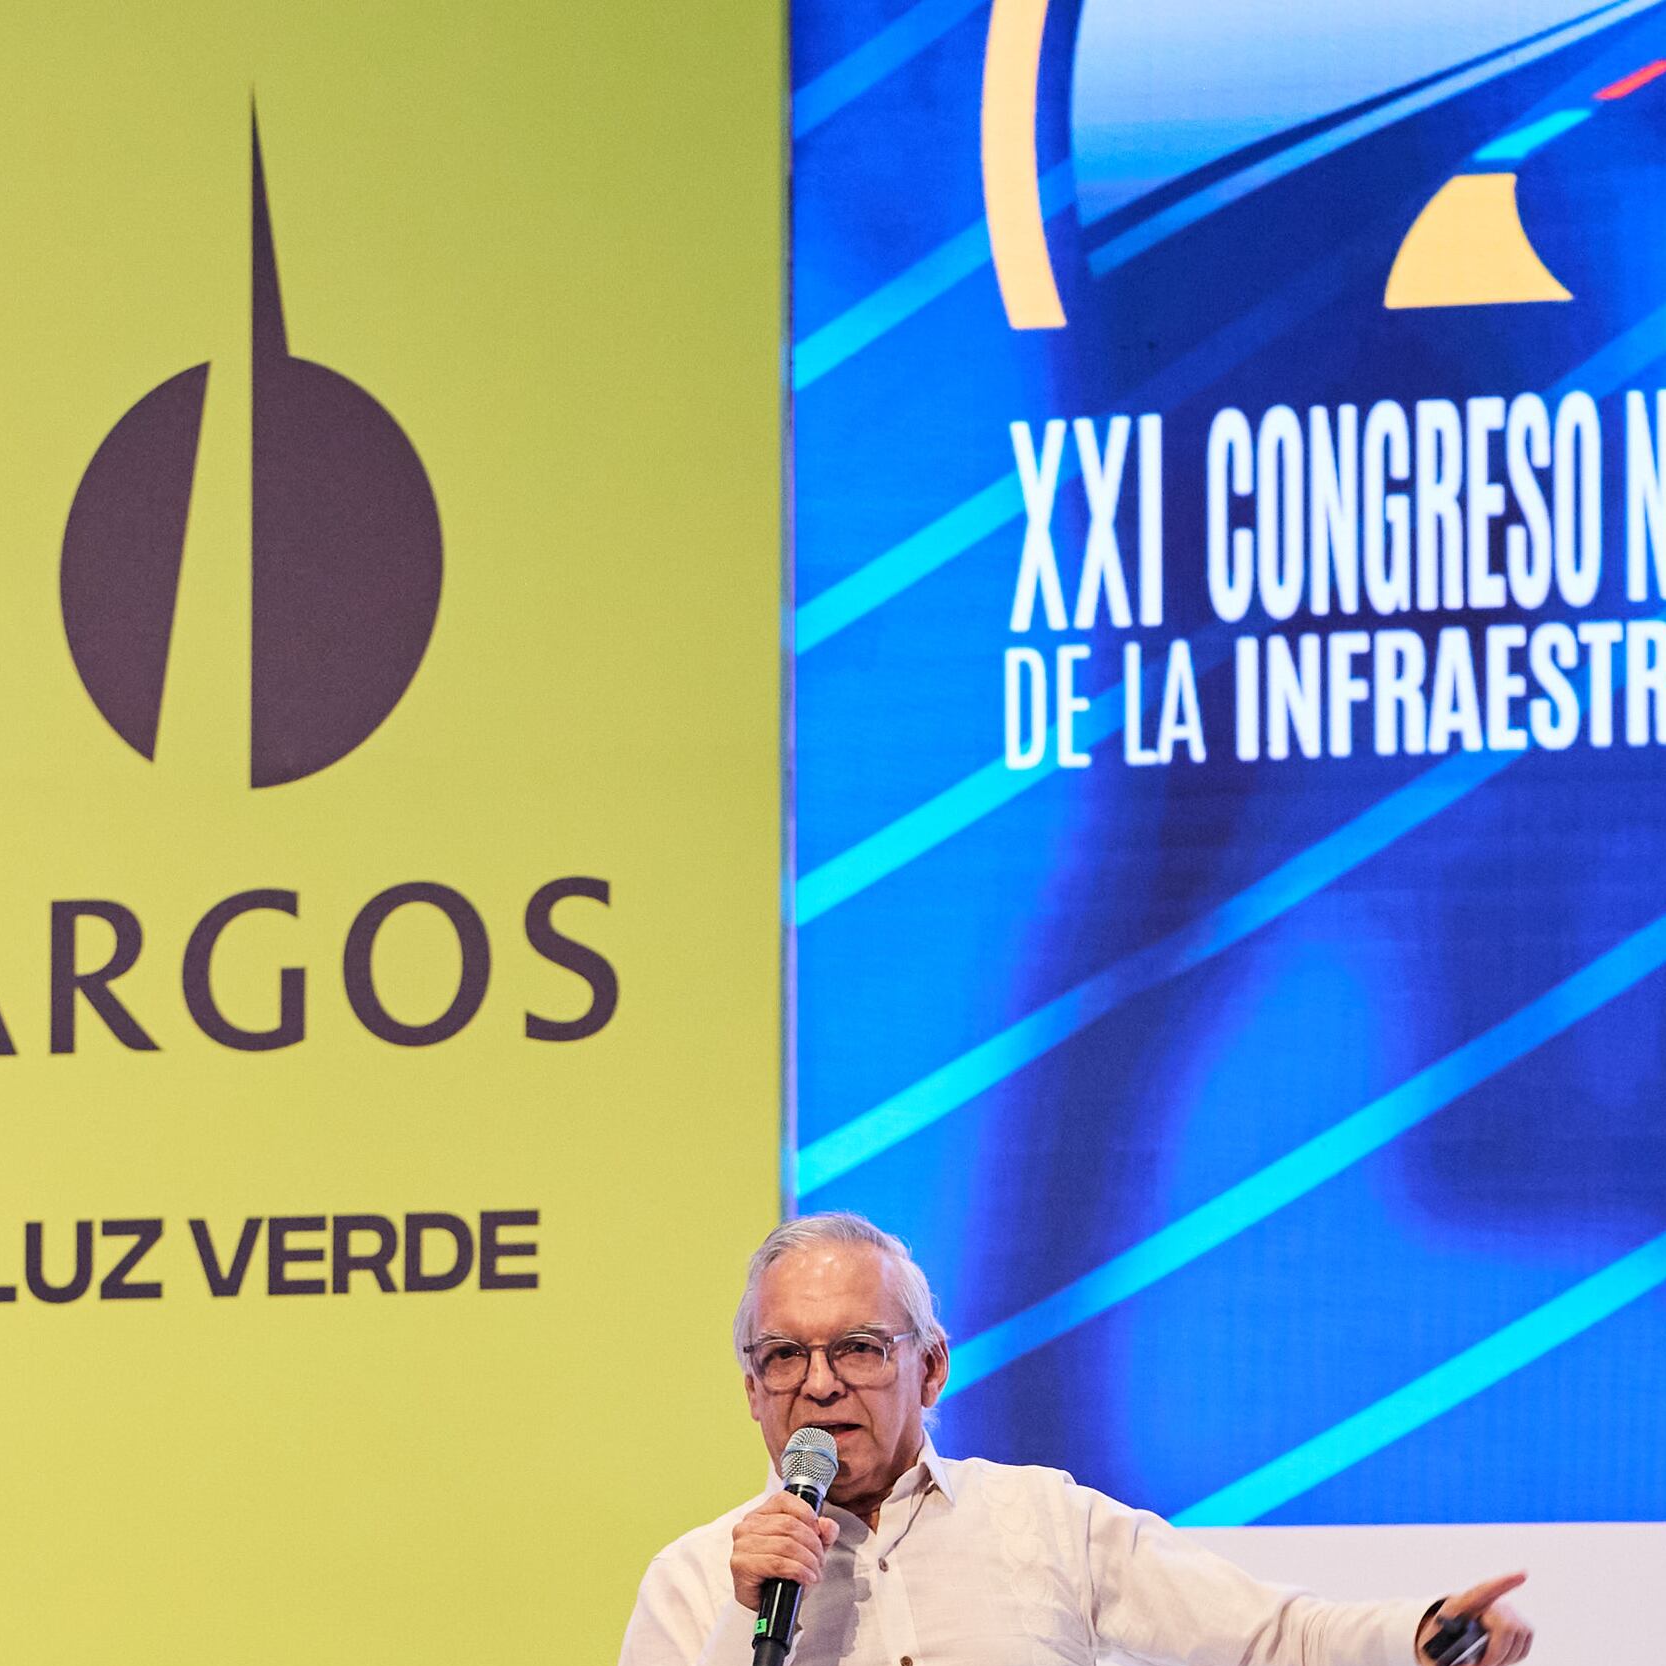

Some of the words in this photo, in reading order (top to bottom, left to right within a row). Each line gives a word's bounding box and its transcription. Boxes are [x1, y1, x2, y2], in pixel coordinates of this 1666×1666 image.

[1009, 413, 1164, 633] XXI
[1206, 390, 1602, 622] CONGRESO
[1004, 641, 1092, 770] DE
[1124, 639, 1206, 765] LA
[188, 1208, 542, 1298] VERDE
